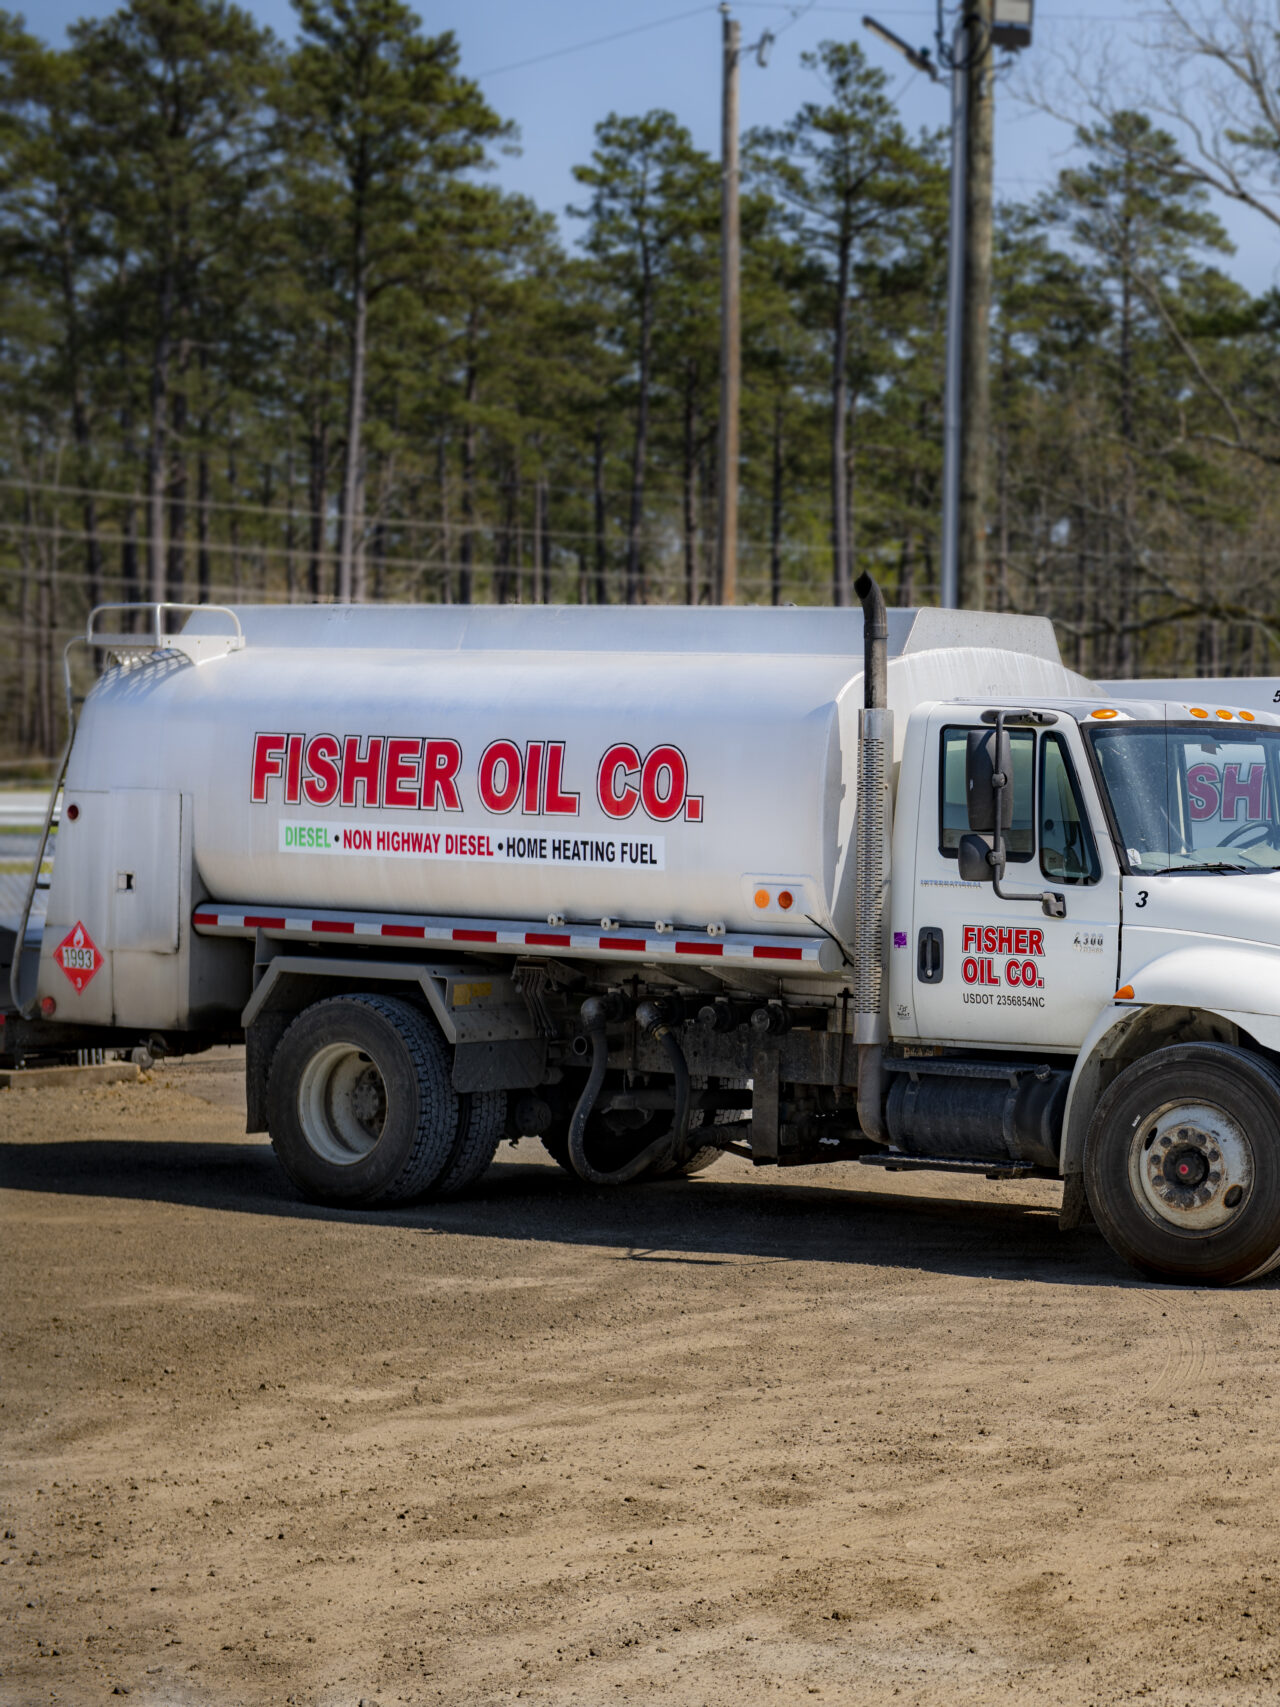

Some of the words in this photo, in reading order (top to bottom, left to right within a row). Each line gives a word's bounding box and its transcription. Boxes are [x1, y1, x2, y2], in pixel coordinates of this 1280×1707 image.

[250, 732, 464, 812] FISHER
[477, 738, 580, 816] OIL
[596, 742, 704, 823] CO.
[284, 826, 332, 849] DIESEL
[343, 828, 372, 851] NON
[376, 830, 441, 854] HIGHWAY
[445, 833, 494, 857] DIESEL
[506, 836, 548, 860] HOME
[551, 838, 616, 863] HEATING
[620, 841, 658, 865] FUEL
[1135, 890, 1149, 908] 3
[962, 924, 1046, 957] FISHER
[64, 948, 93, 969] 1993
[961, 956, 1000, 987] OIL
[1005, 958, 1045, 989] CO.
[962, 992, 994, 1005] USDOT
[996, 994, 1046, 1008] 2356854NC
